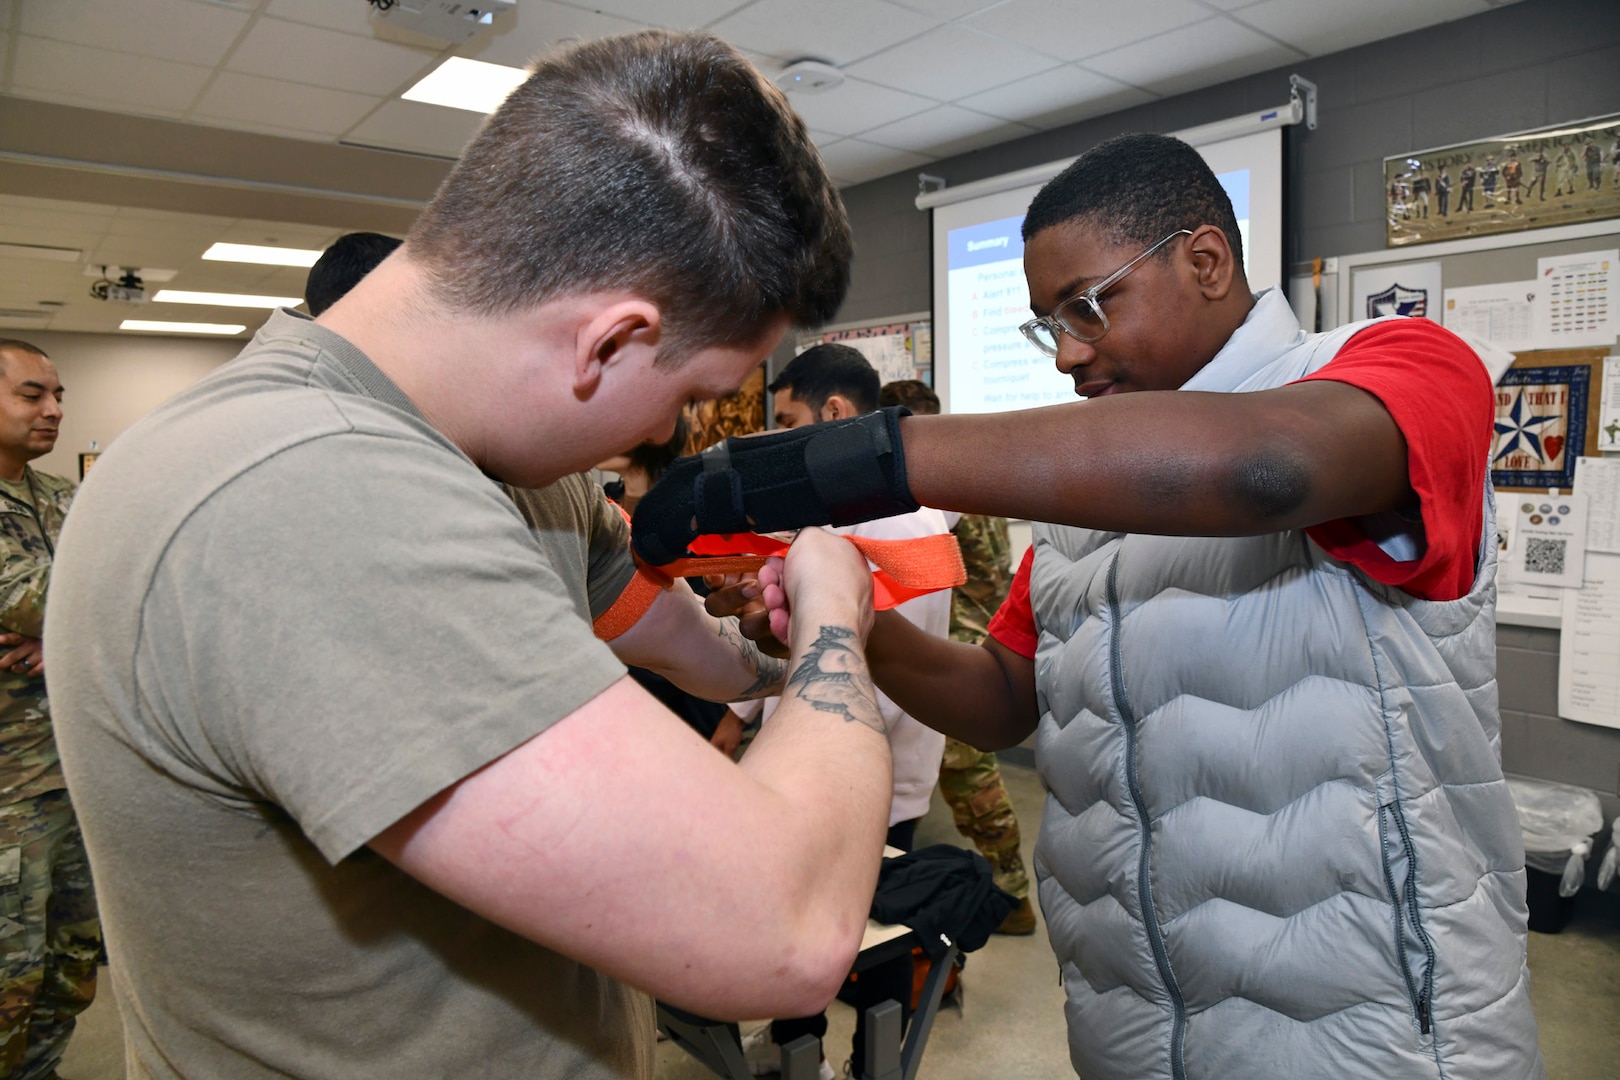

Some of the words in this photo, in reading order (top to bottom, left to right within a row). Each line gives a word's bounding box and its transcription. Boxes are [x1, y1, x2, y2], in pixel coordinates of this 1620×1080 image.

[967, 236, 1010, 252] Summary
[978, 269, 1017, 282] Personal
[983, 287, 1004, 300] Alert
[983, 306, 1003, 318] Find
[983, 358, 1029, 371] Compress
[1005, 390, 1019, 402] for
[1020, 390, 1040, 402] help
[1528, 391, 1557, 405] THAT
[1504, 455, 1531, 469] LOVE
